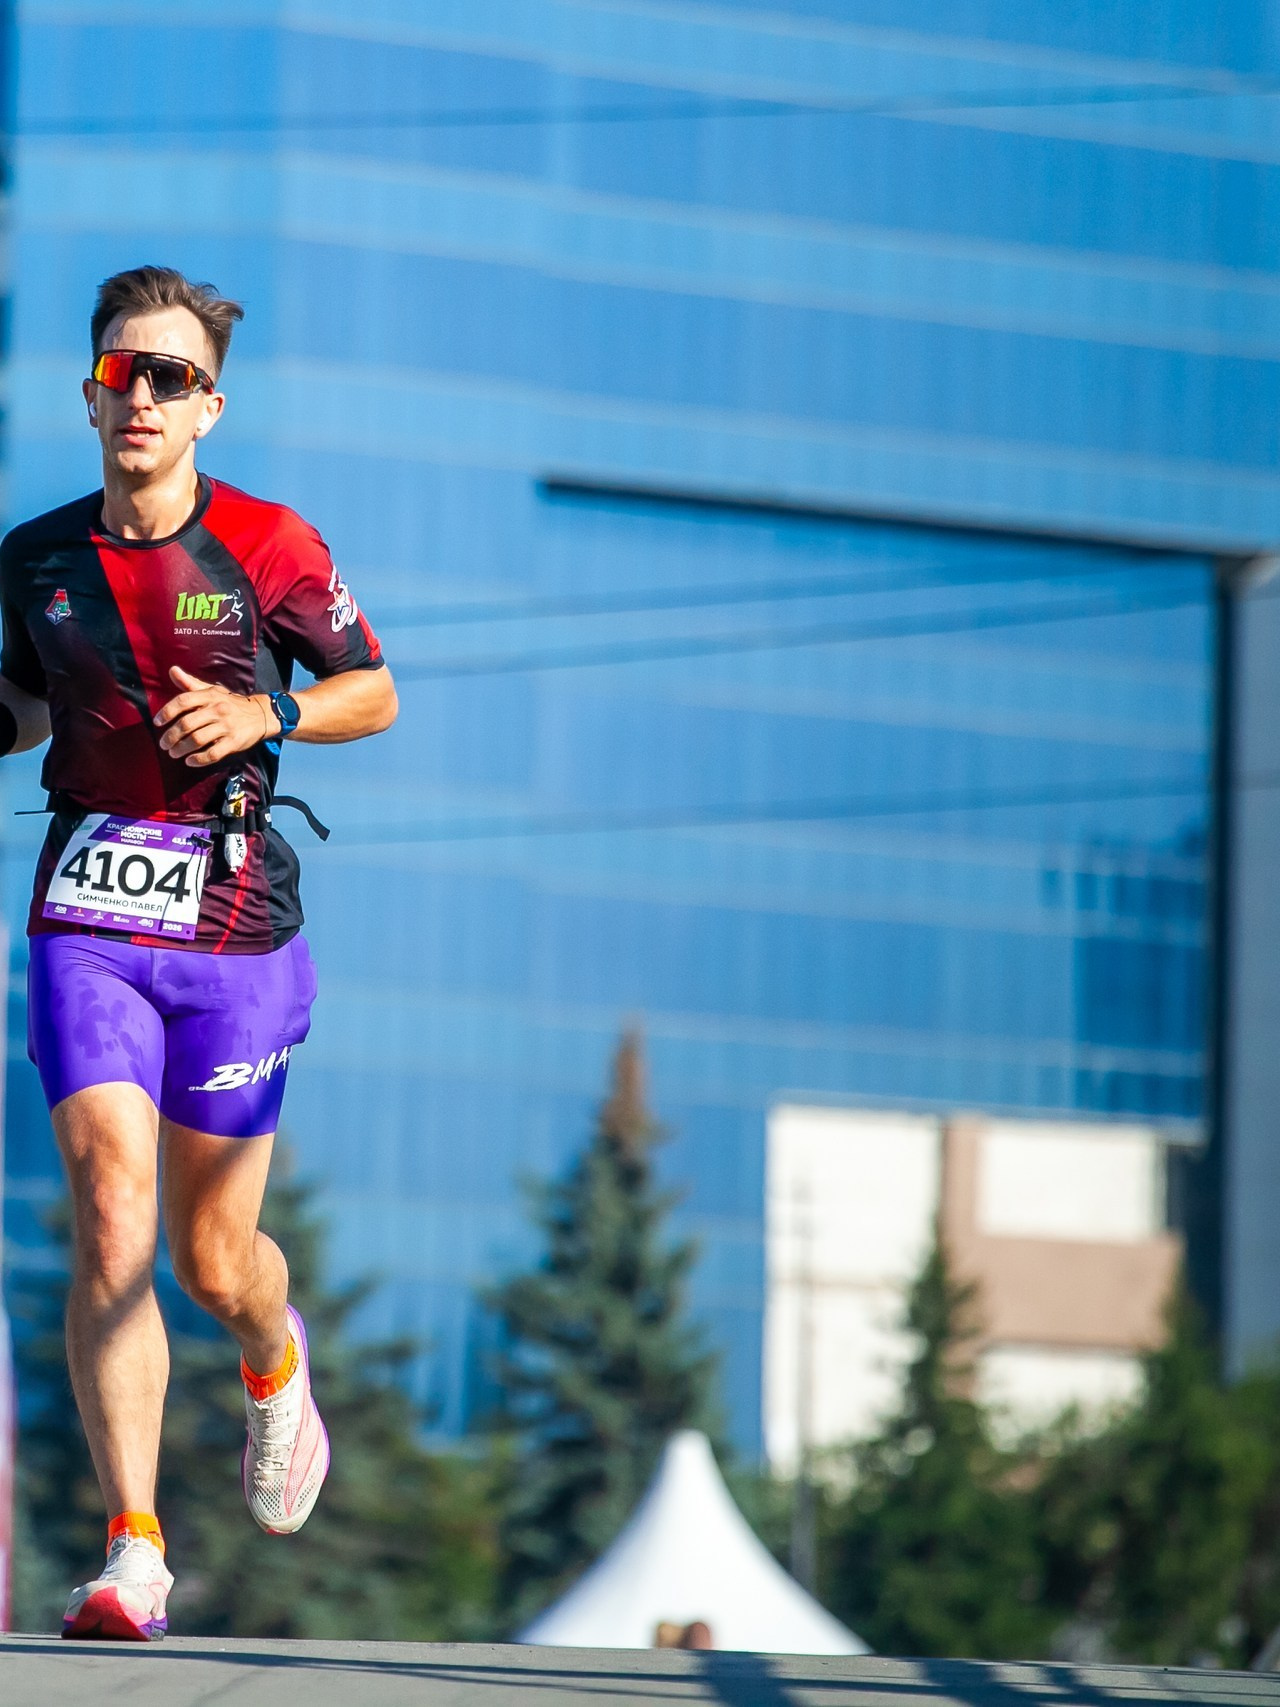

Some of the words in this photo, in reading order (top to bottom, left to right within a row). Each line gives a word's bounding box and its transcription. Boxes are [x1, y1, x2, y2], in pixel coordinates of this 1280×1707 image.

[202, 628, 241, 636] Солнечный
[106, 822, 163, 837] КРАСНОЯРСКИЕ
[120, 830, 147, 841] МОСТЫ
[60, 846, 191, 903] 4104
[77, 893, 129, 908] СИМЧЕНКО
[131, 901, 163, 912] ПАВЕЛ
